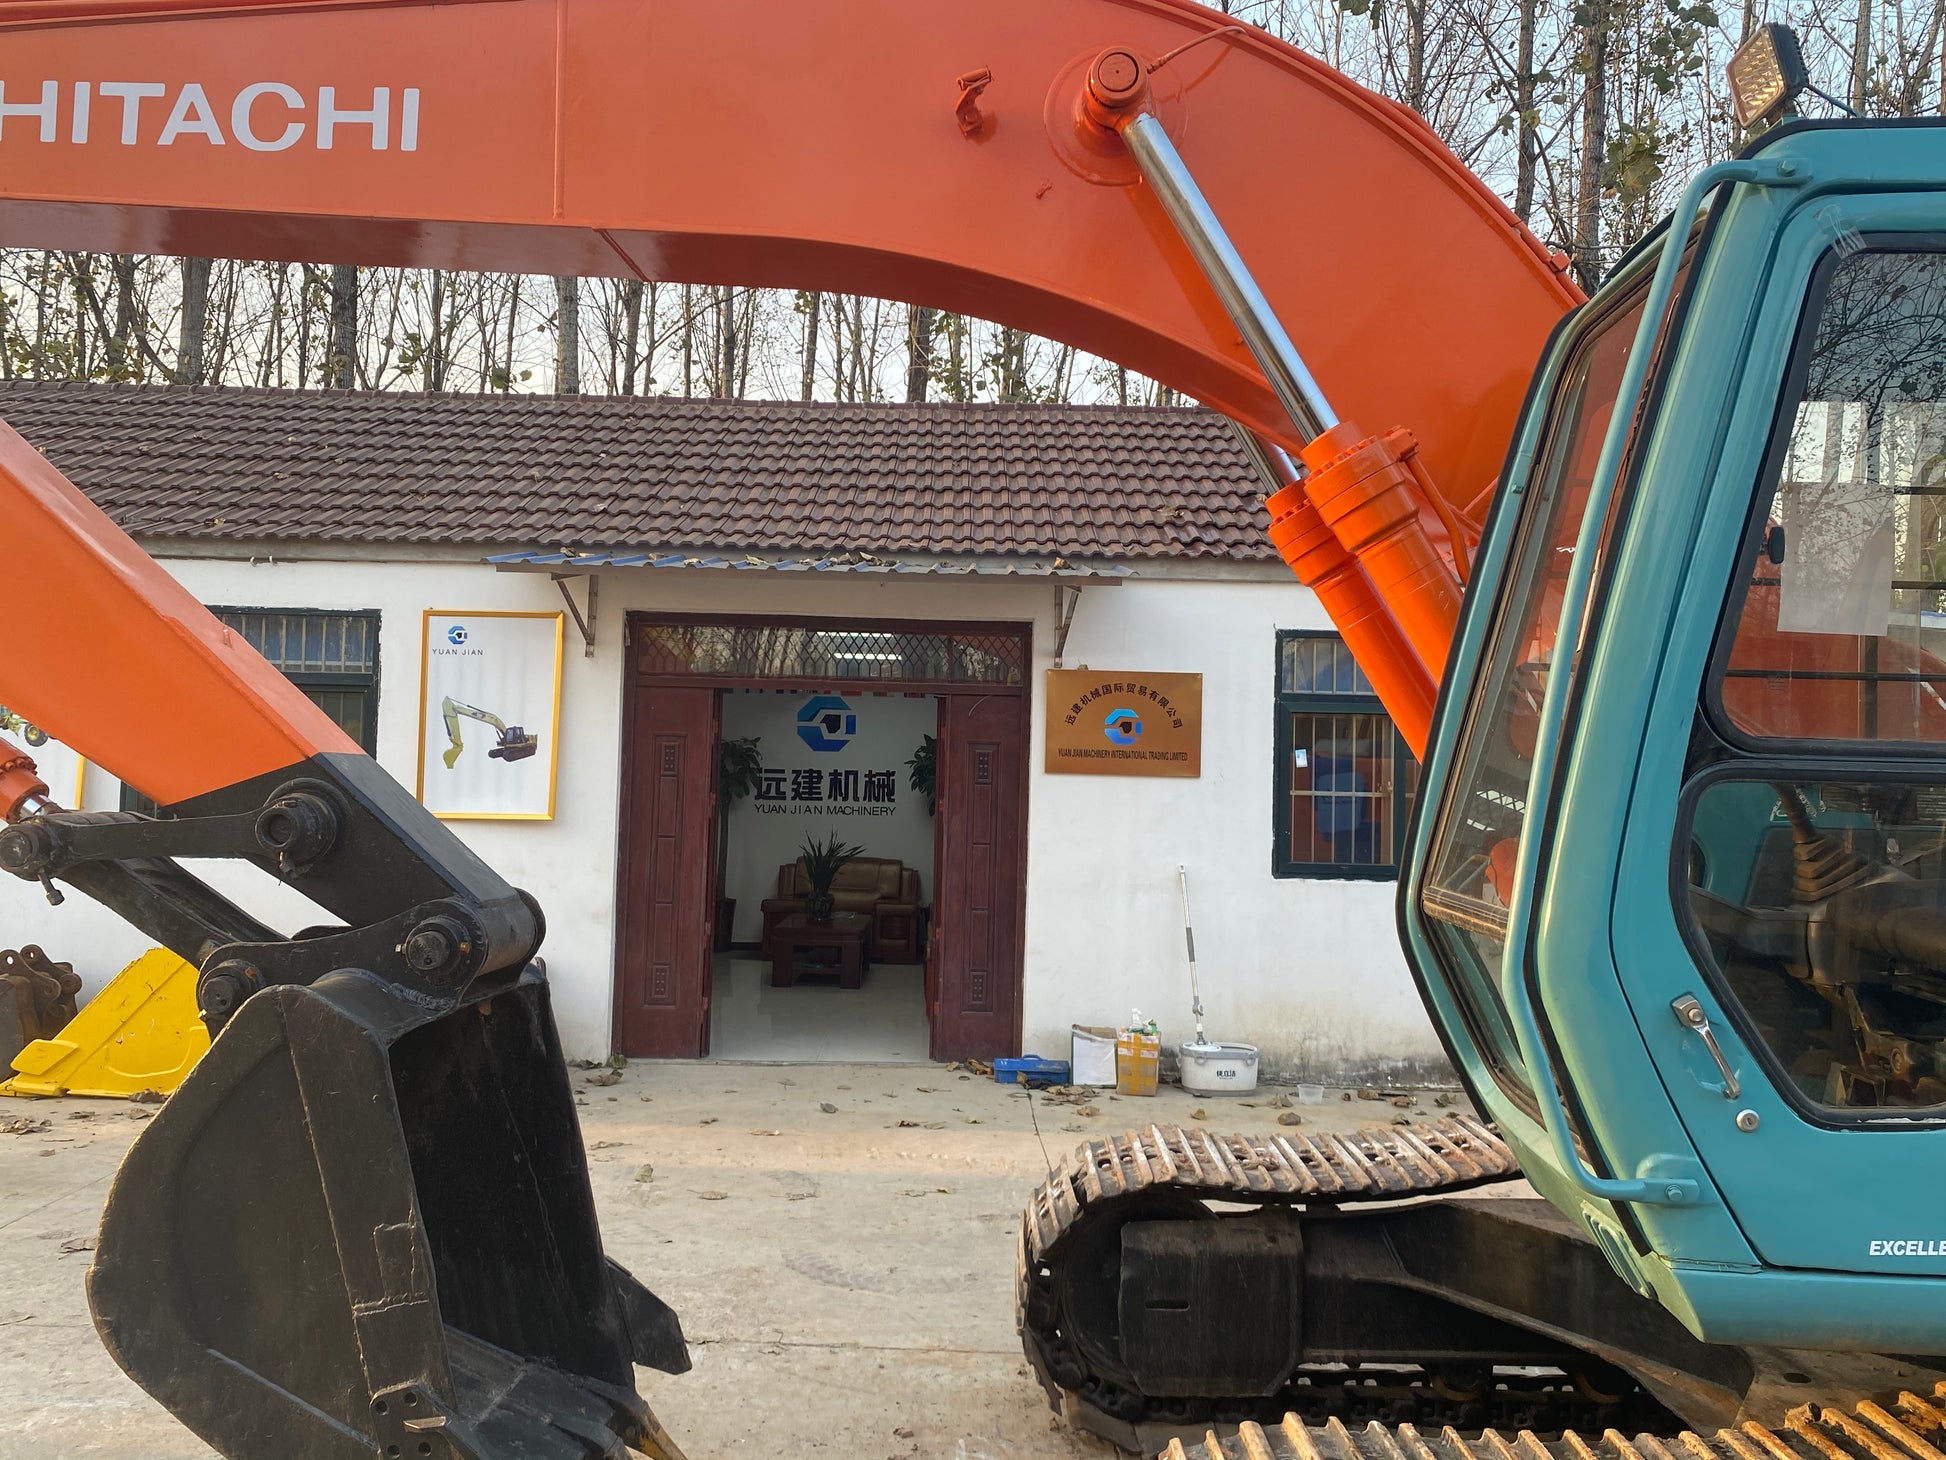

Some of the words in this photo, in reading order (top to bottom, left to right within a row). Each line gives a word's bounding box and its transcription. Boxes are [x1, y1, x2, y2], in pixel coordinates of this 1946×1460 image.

[0, 80, 420, 151] HITACHI
[432, 648, 458, 656] YUAN
[1065, 683, 1183, 729] 远建机械国际贸易有限公司
[1058, 748, 1071, 758] YUAN
[1072, 748, 1083, 758] JIAN
[1083, 749, 1110, 759] MACHINERY
[1110, 750, 1147, 760] INTERNATIONAL
[1148, 751, 1169, 761] TRADING
[1169, 752, 1188, 761] LIMITED
[755, 768, 896, 802] 远建机械
[755, 804, 787, 814] YUAN
[791, 805, 823, 815] JIAN
[827, 805, 896, 816] MACHINERY
